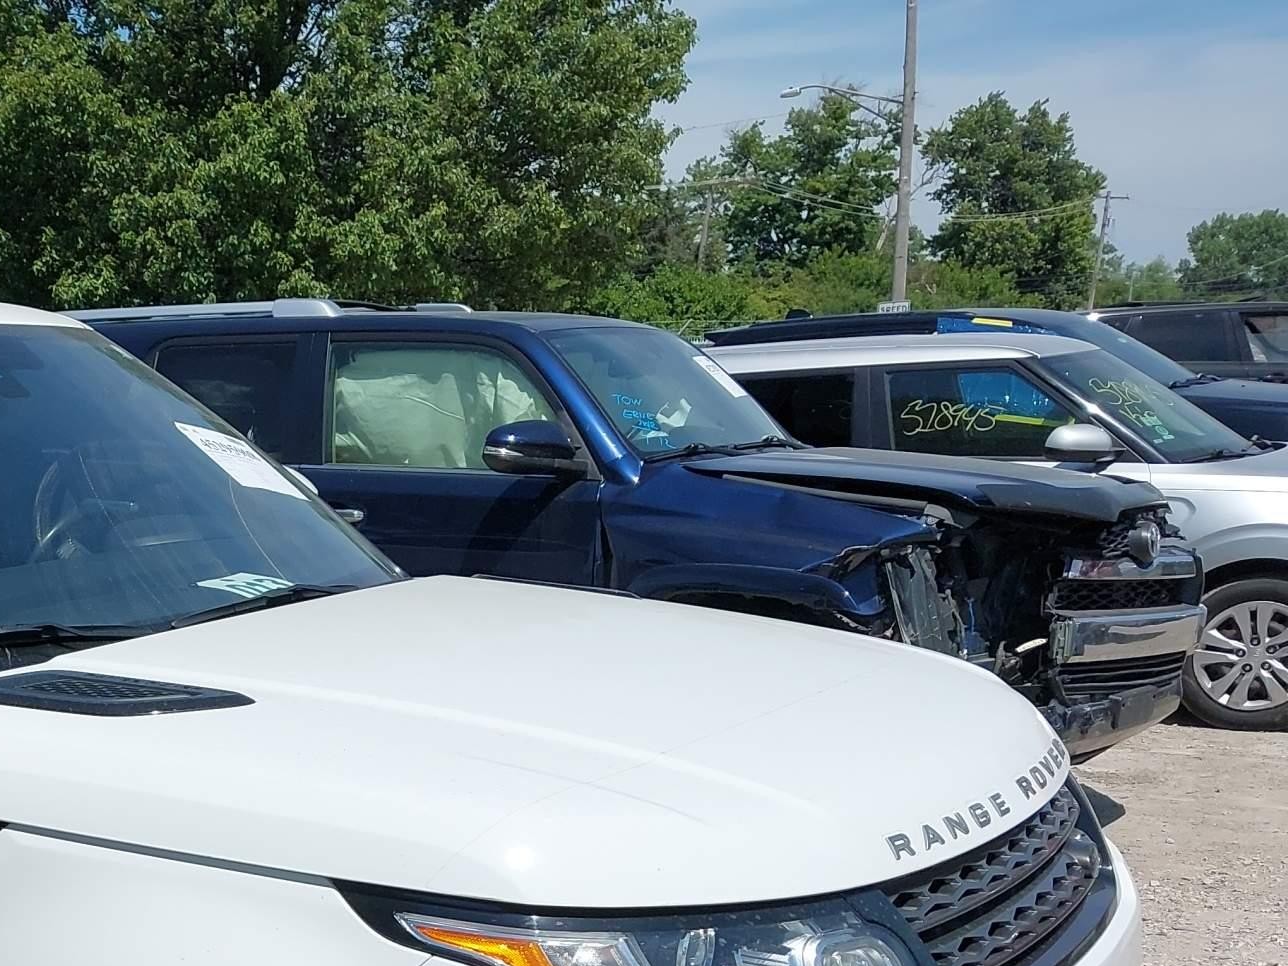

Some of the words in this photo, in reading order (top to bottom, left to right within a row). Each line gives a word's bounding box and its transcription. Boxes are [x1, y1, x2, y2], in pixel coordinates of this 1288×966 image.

[612, 393, 643, 407] TOW
[885, 792, 1011, 861] RANGE
[1015, 738, 1066, 801] ROVER
